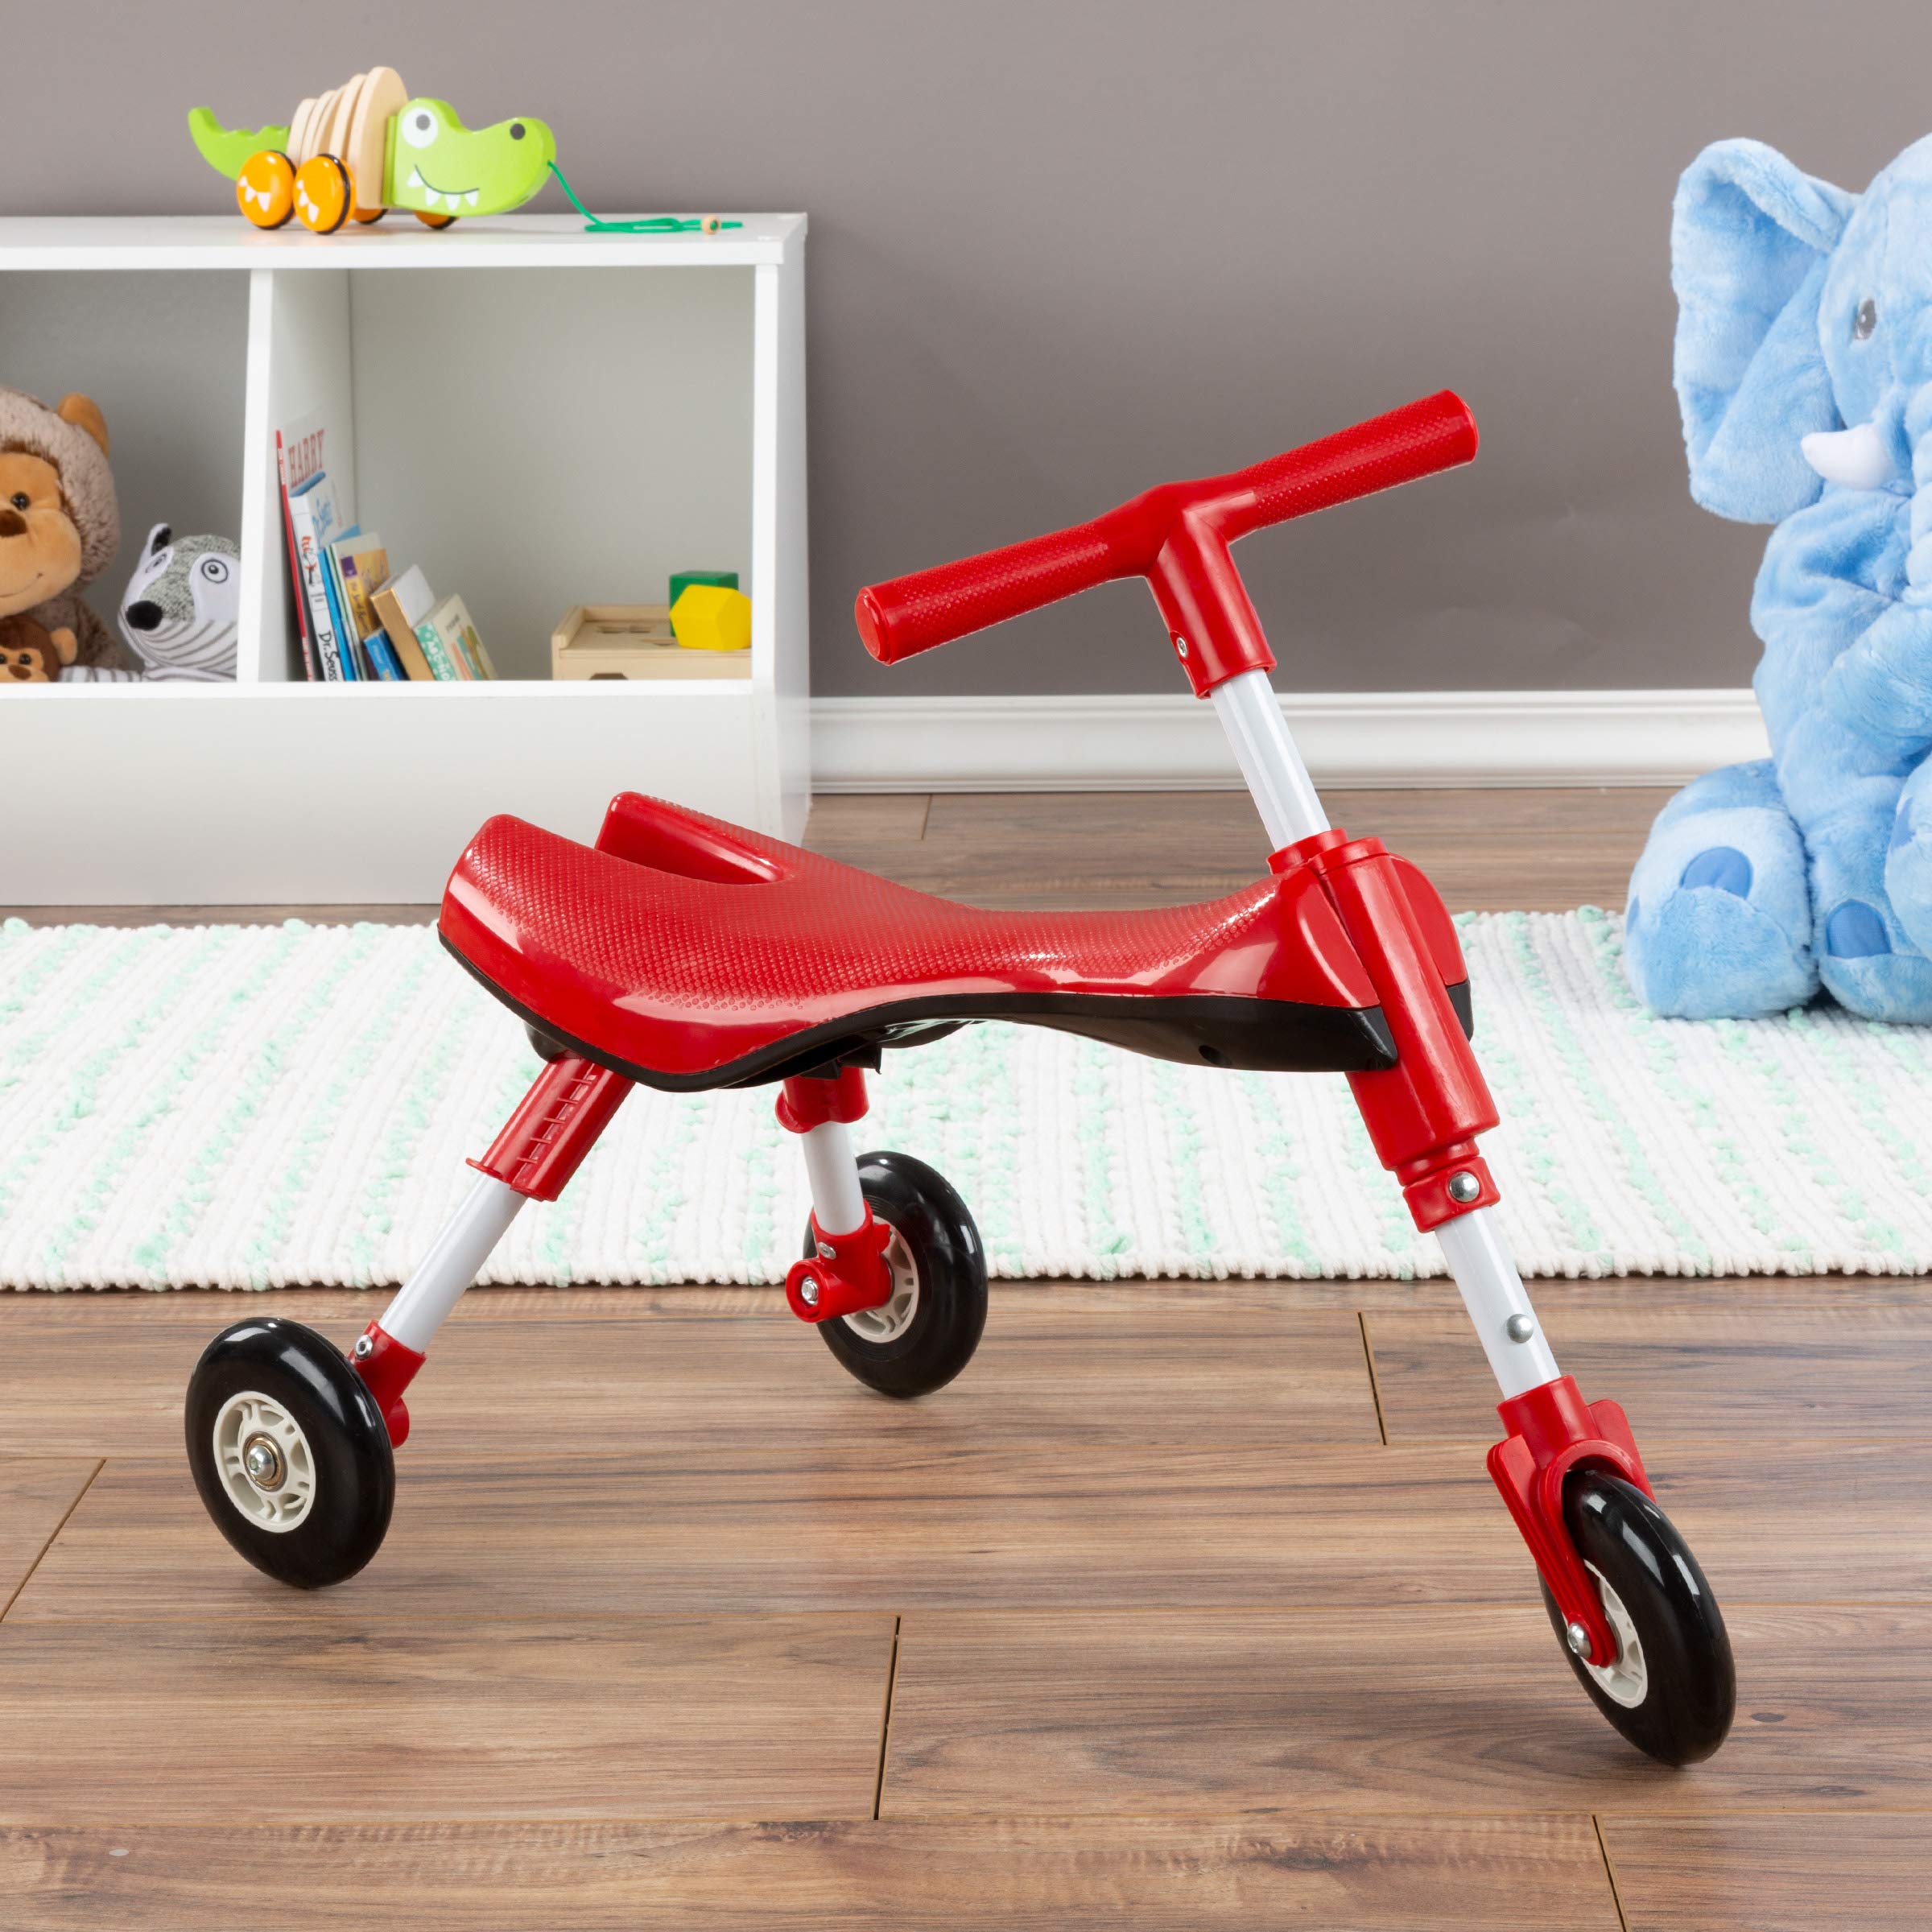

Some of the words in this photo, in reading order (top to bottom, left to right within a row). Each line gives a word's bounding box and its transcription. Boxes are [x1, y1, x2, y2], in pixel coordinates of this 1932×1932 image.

[288, 428, 324, 488] HARRY
[319, 630, 332, 650] Dr.
[324, 651, 339, 682] Seuss
